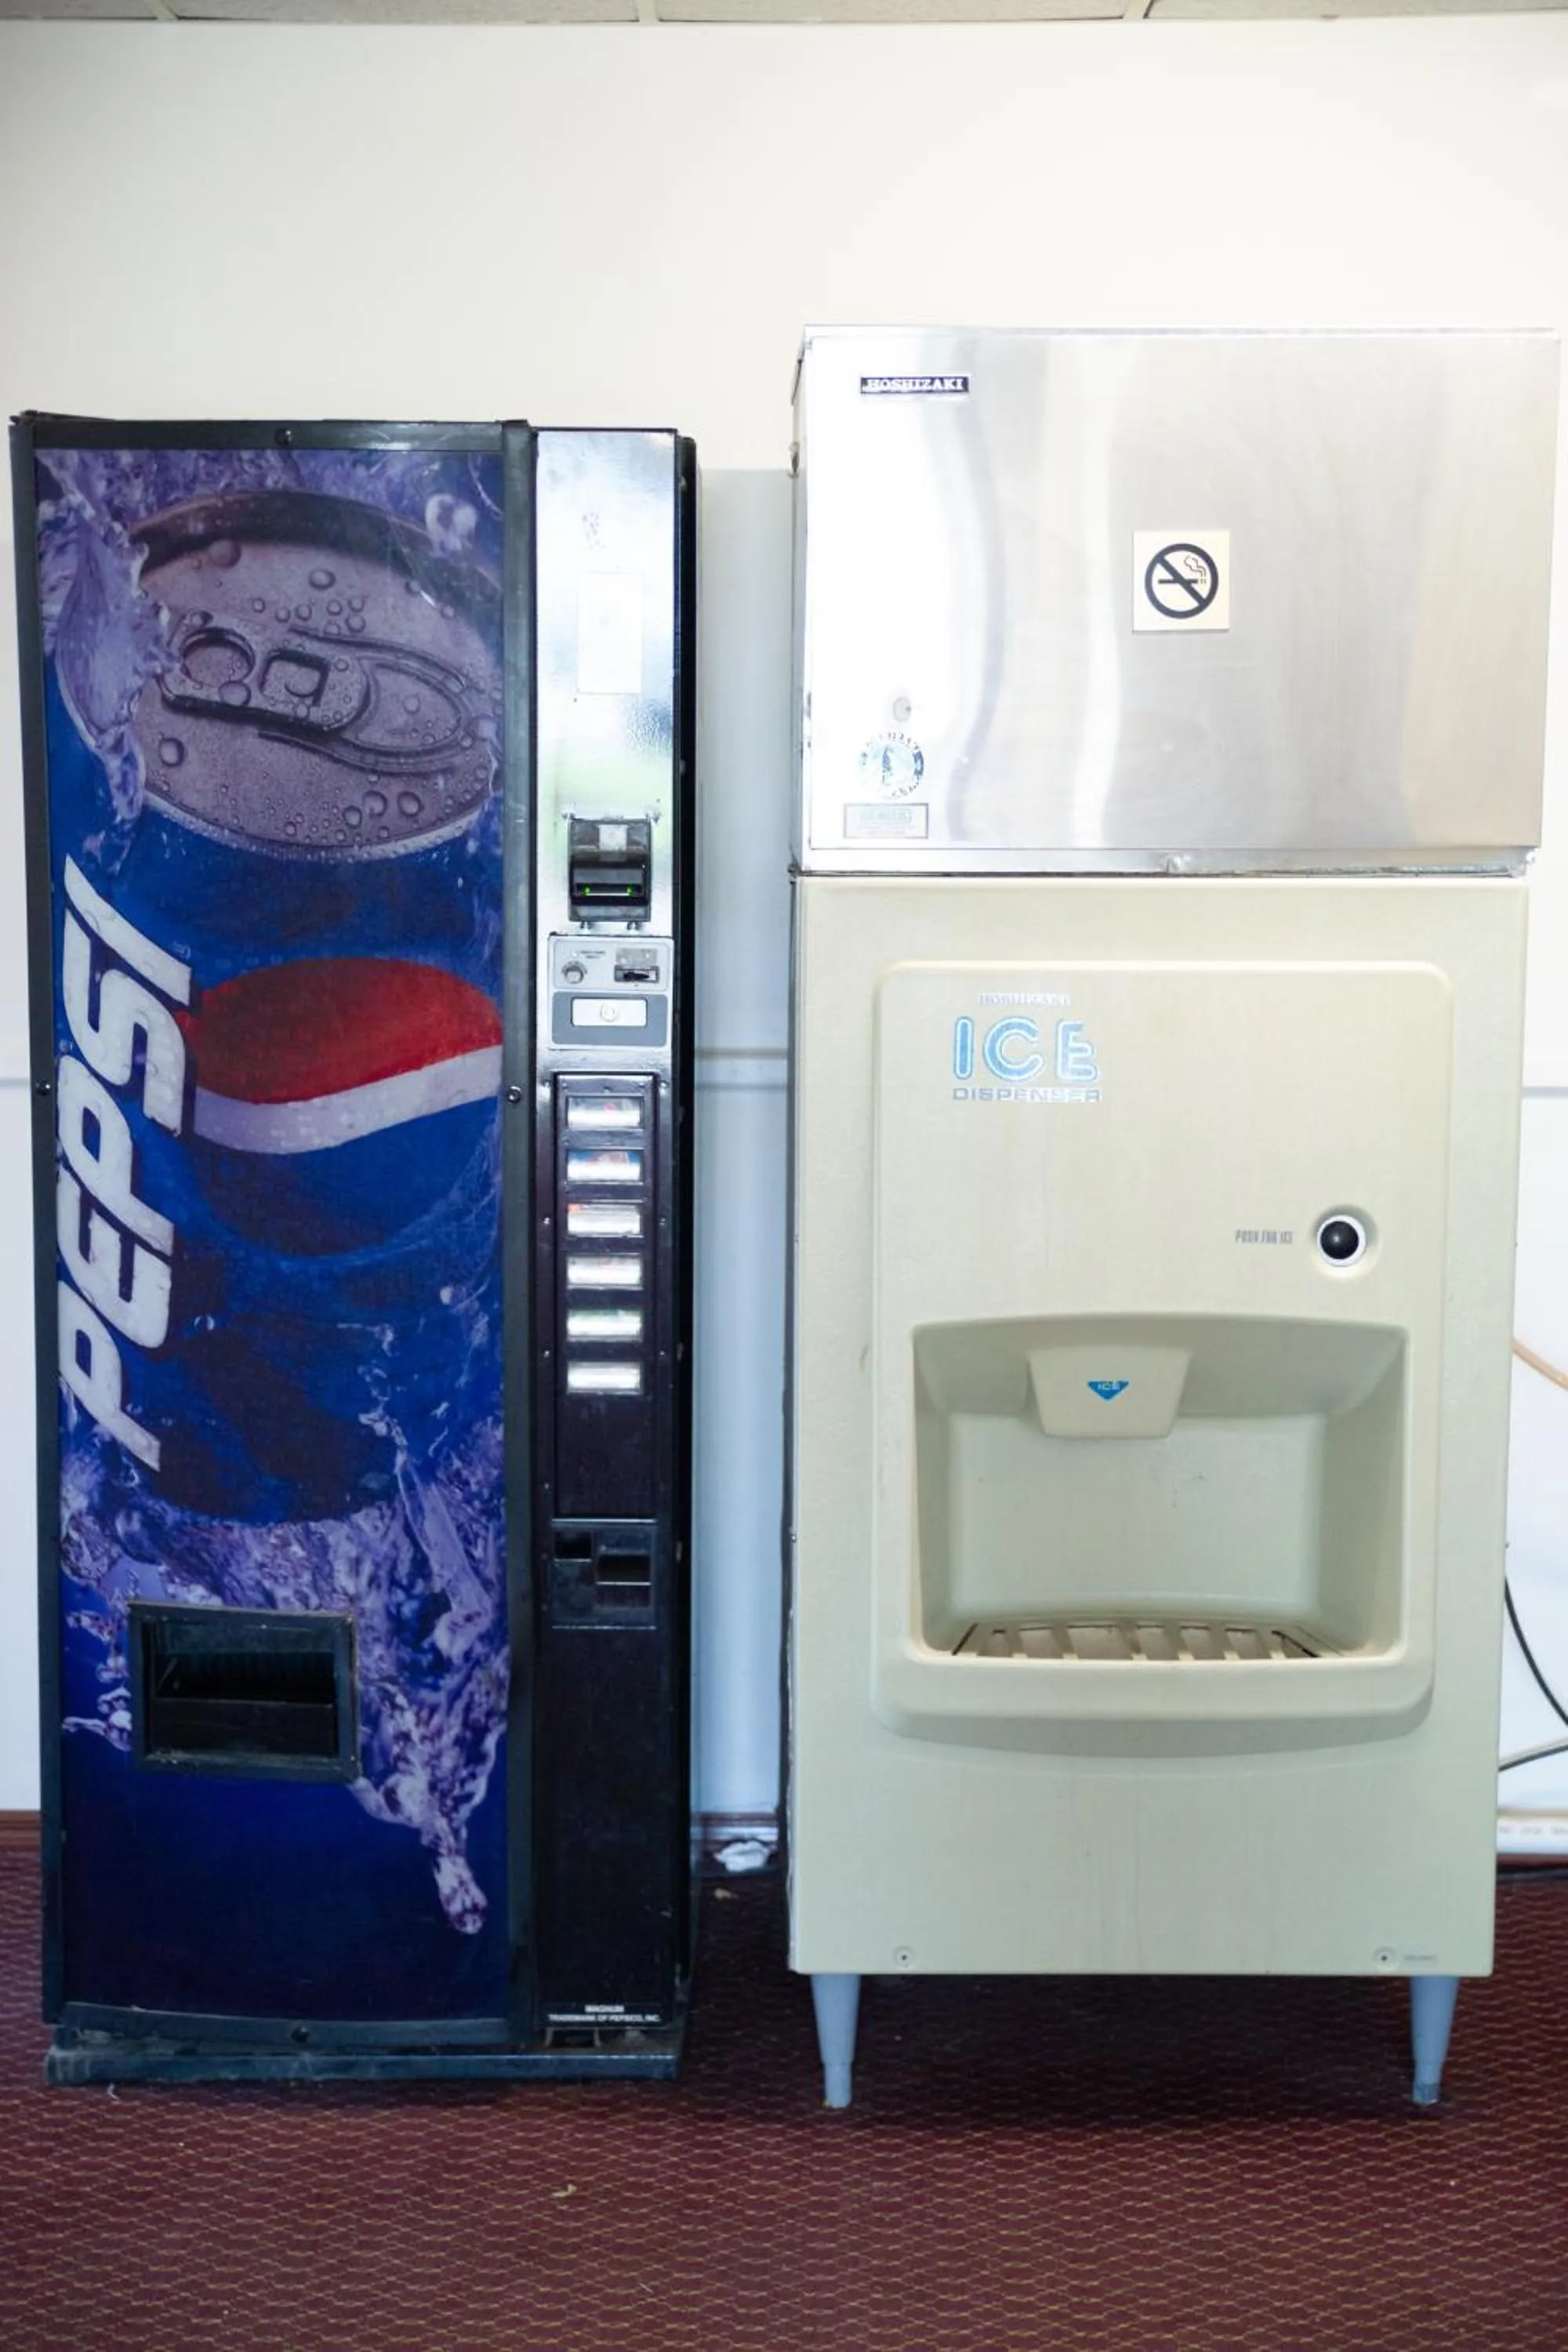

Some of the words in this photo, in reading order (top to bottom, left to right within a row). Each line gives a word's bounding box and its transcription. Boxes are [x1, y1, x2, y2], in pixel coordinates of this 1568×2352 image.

[863, 378, 964, 391] HOSHIZAKI
[953, 1015, 1101, 1083] ICE
[953, 1087, 1101, 1102] DISPENSER
[57, 855, 193, 1473] PEPSI
[1235, 1229, 1260, 1244] PUSH
[1261, 1230, 1277, 1245] FOR
[1280, 1231, 1294, 1244] ICE
[597, 2014, 608, 2023] OF
